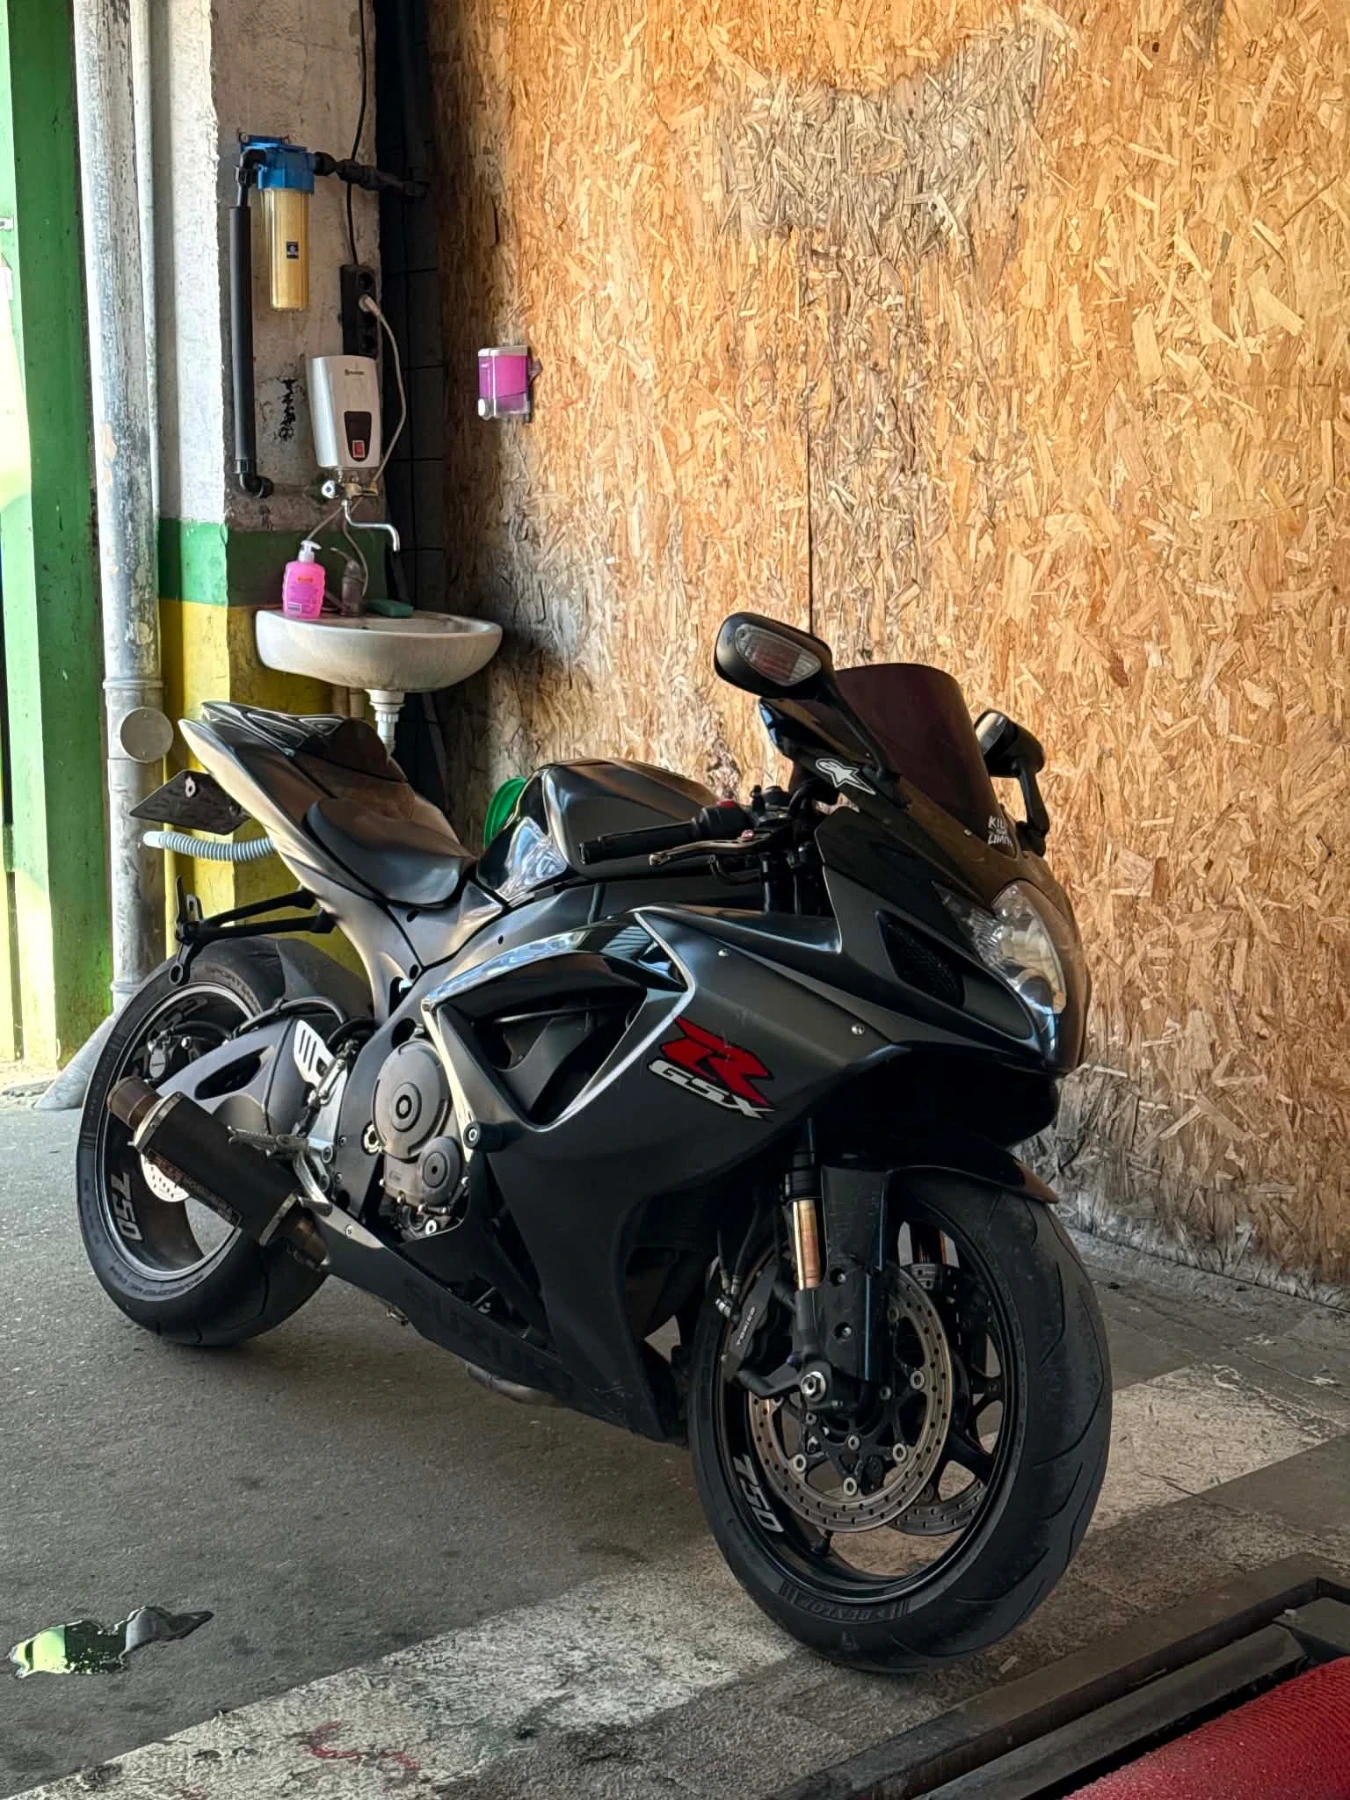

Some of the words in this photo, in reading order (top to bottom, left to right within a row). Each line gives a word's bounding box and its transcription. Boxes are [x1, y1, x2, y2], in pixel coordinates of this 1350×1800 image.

[649, 1059, 775, 1119] GSX
[111, 1172, 142, 1240] 750
[733, 1454, 784, 1532] 750
